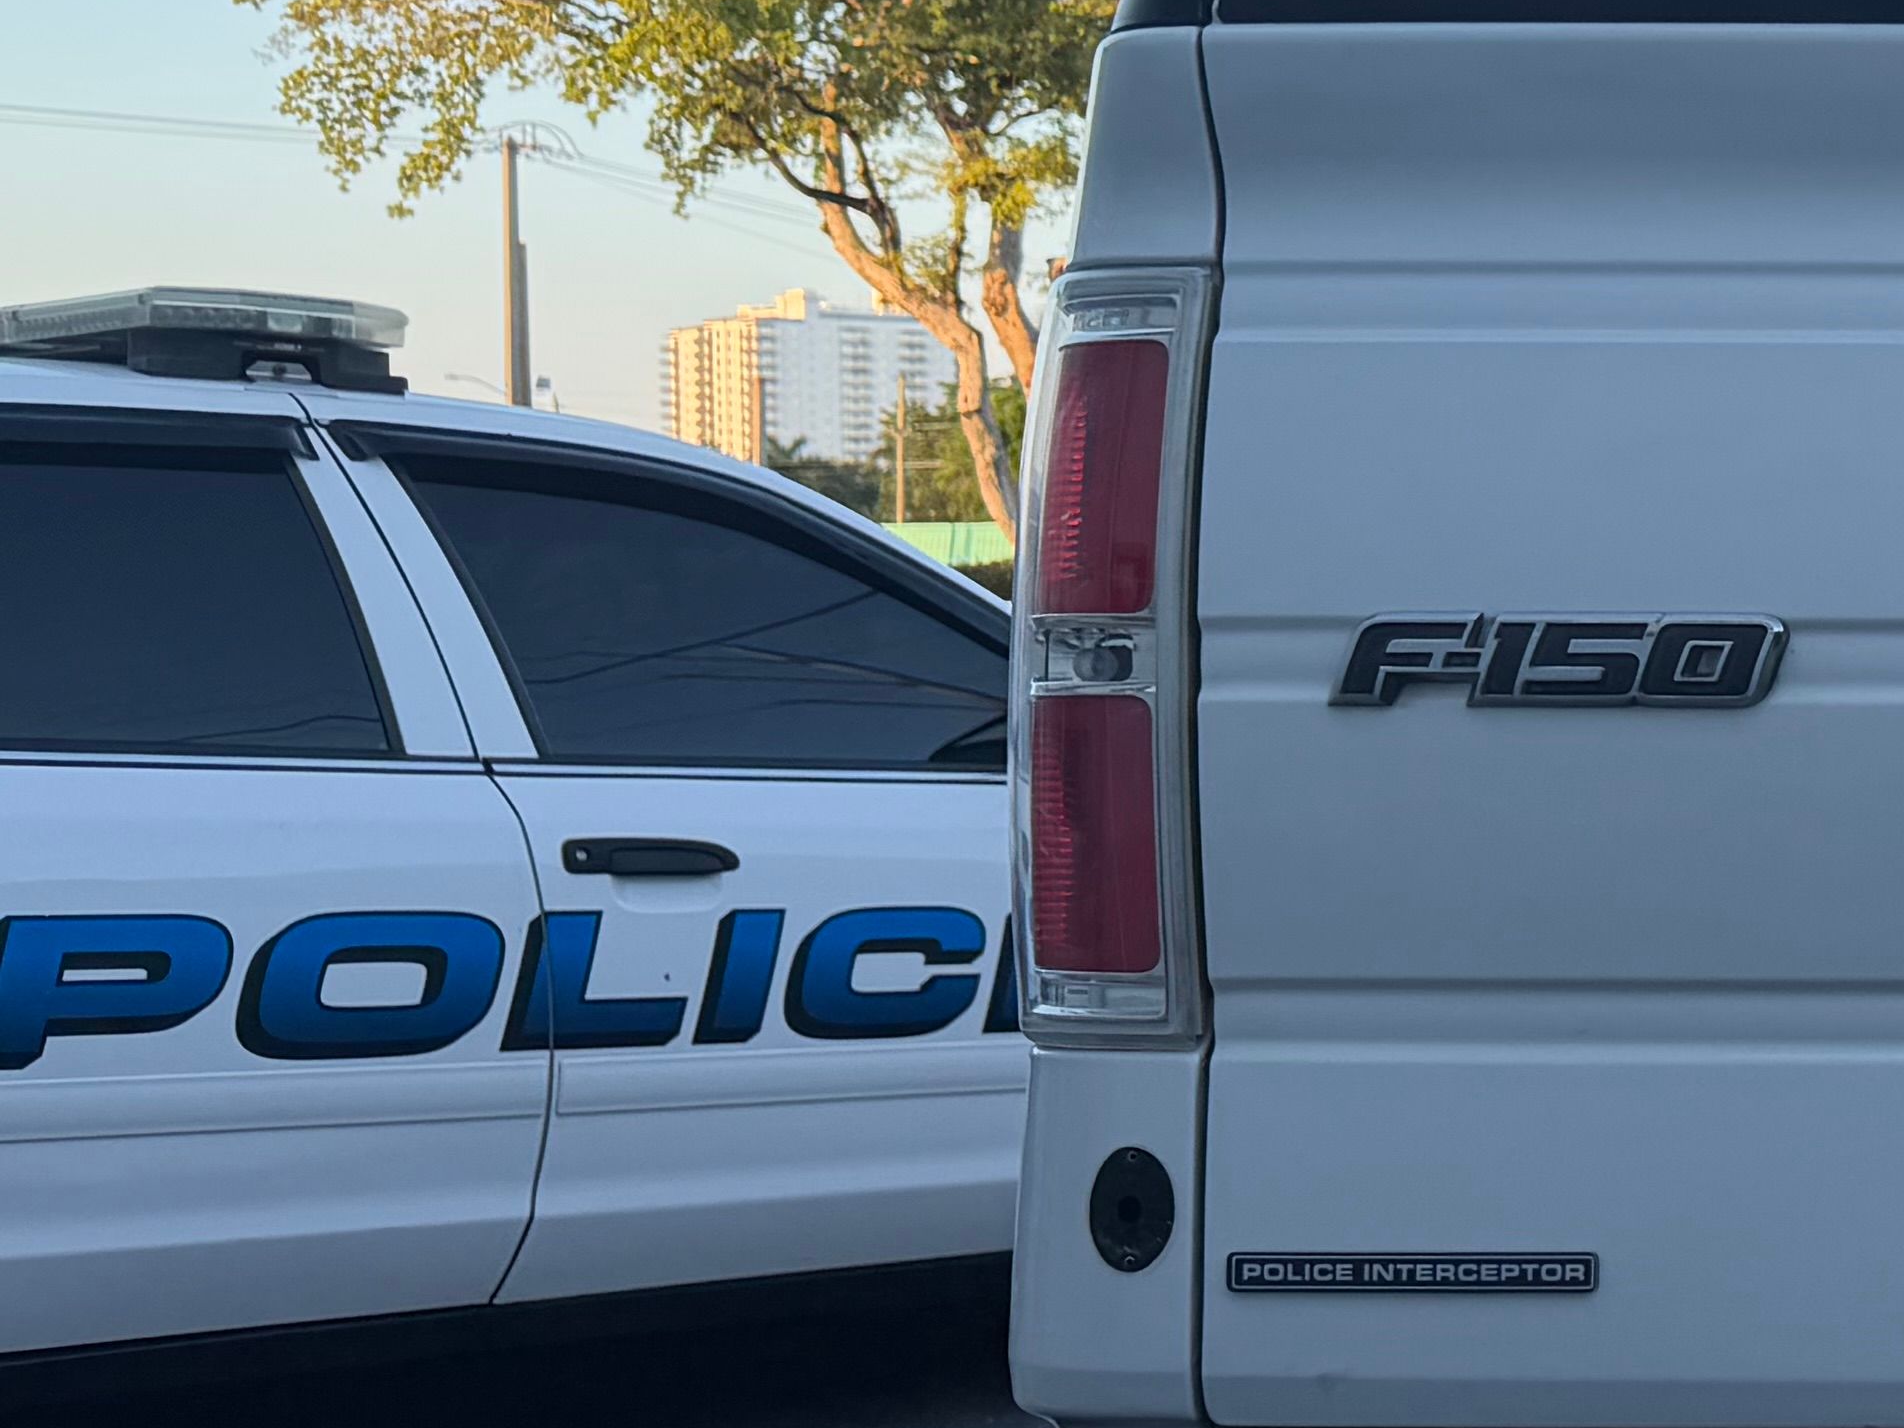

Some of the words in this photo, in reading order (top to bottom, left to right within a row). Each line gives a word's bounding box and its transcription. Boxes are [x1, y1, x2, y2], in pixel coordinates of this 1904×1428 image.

[1328, 612, 1790, 707] F-150
[0, 907, 1021, 1070] POLIC
[1243, 1263, 1354, 1282] POLICE
[1363, 1263, 1587, 1282] INTERCEPTOR
